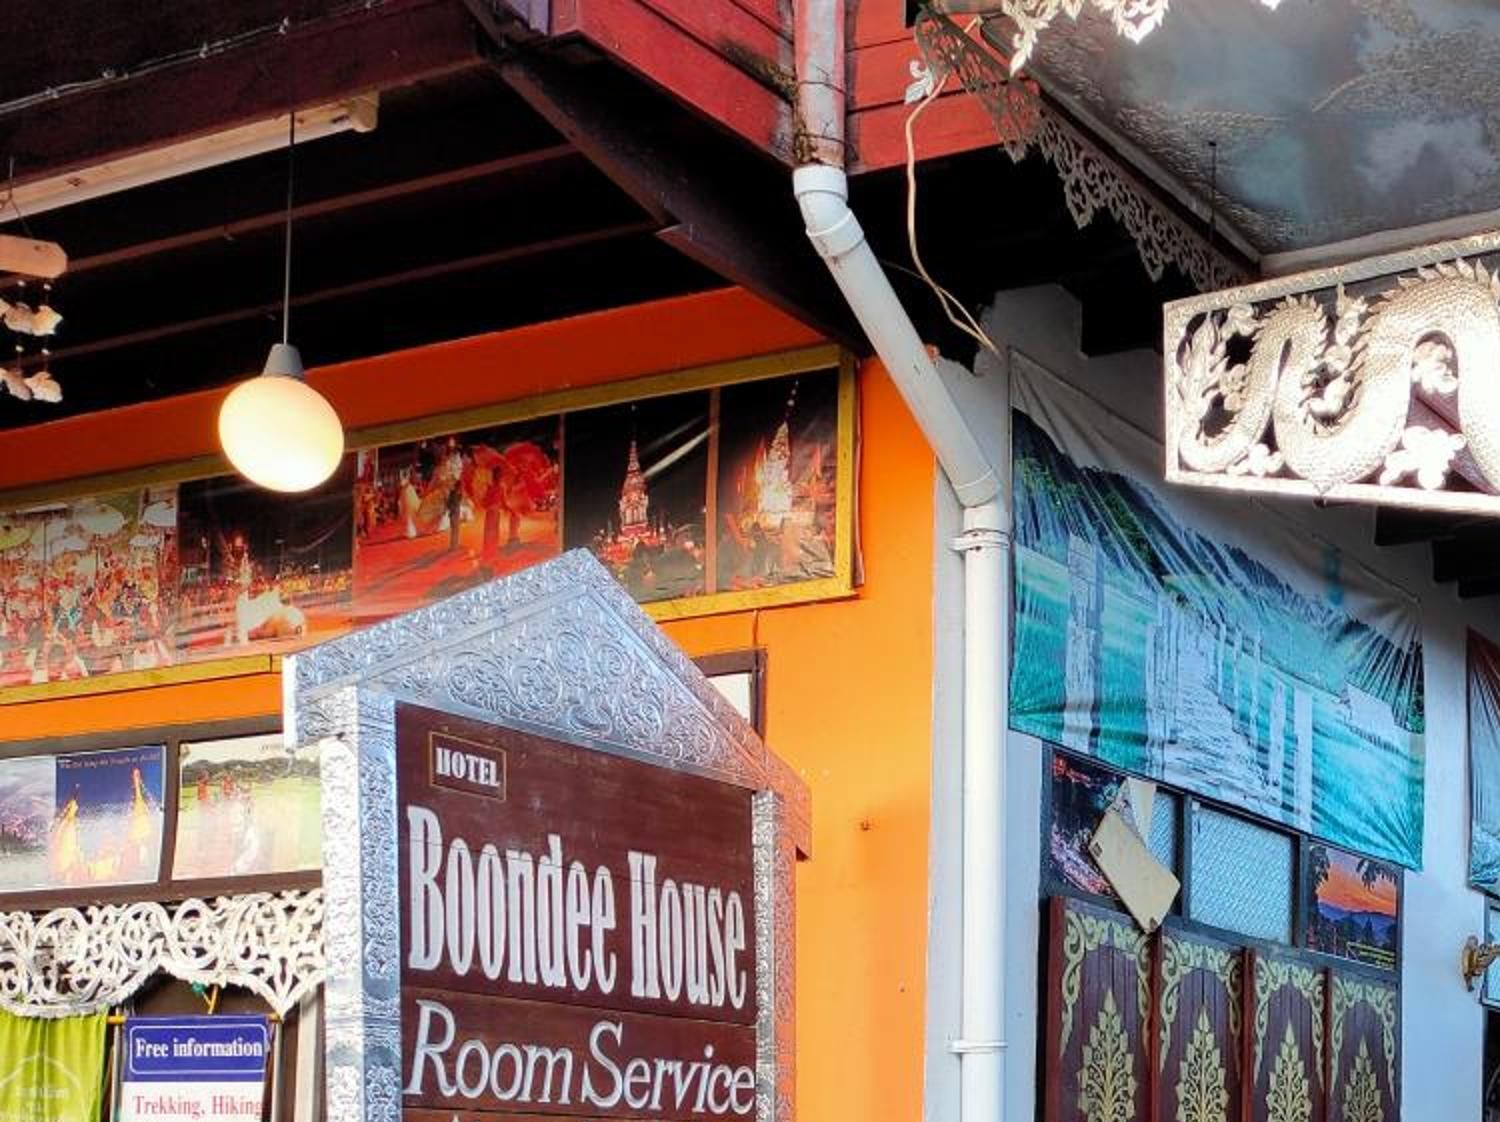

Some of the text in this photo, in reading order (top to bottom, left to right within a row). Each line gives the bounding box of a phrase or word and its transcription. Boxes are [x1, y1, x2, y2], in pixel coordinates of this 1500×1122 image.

[436, 747, 500, 789] HOTEL
[406, 806, 747, 1010] Boondee House
[135, 1036, 263, 1058] Free information
[407, 999, 756, 1116] Room Service
[211, 1095, 262, 1120] Hiking
